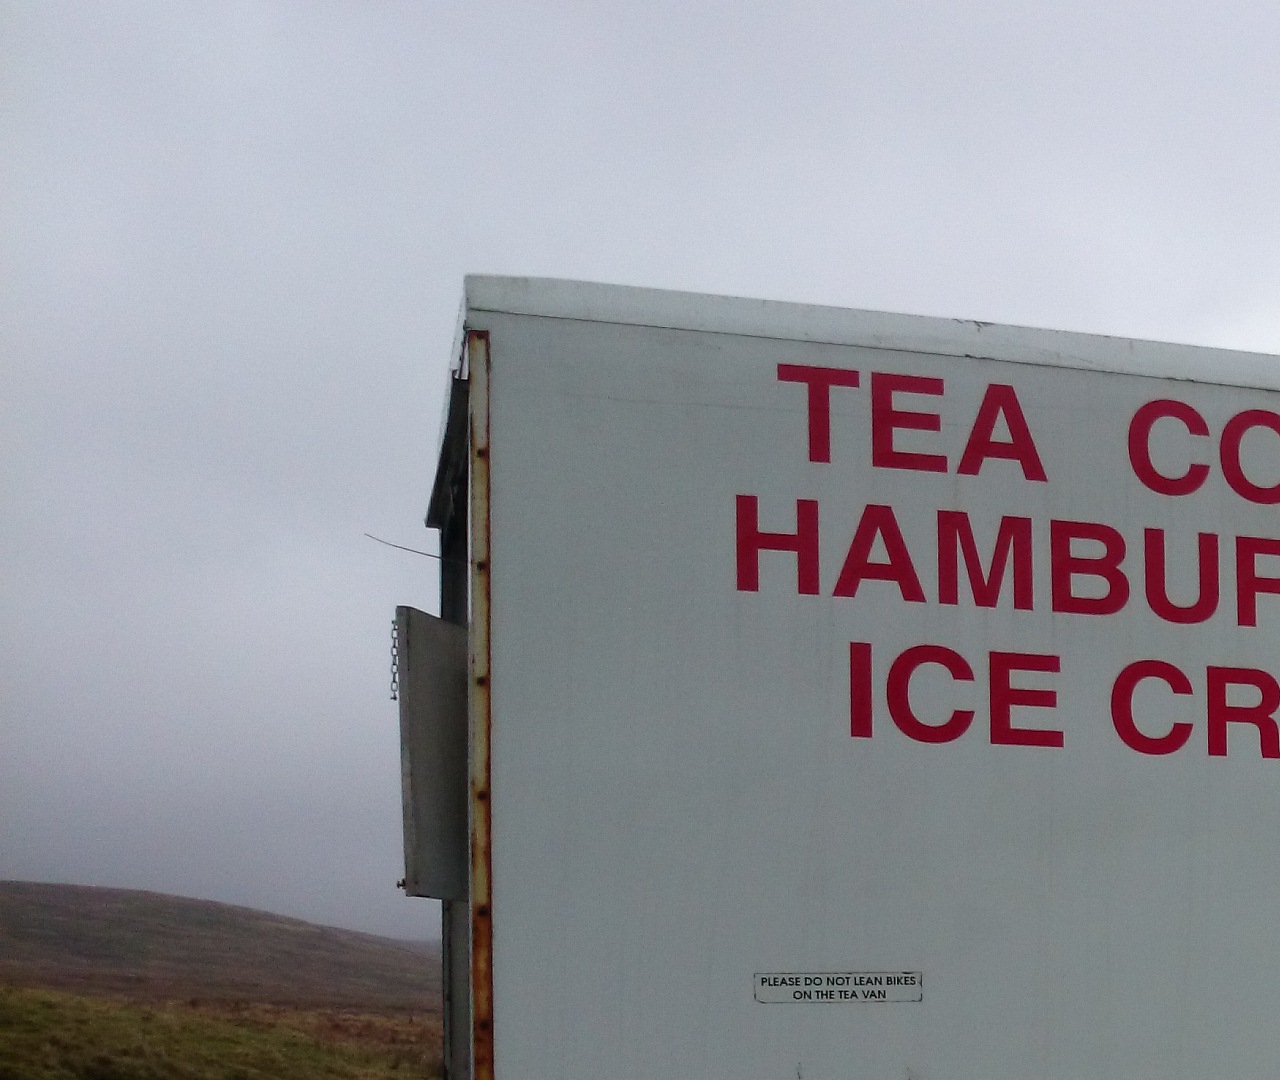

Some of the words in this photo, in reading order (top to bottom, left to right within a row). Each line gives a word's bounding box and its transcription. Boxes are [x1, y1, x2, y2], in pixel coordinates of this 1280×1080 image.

[778, 364, 1046, 481] TEA
[850, 642, 1063, 748] ICE
[760, 976, 801, 987] PLEASE
[804, 976, 823, 987] DO
[826, 976, 850, 986] NOT
[853, 976, 883, 986] LEAN
[886, 975, 917, 986] BIKES
[793, 990, 812, 1000] ON
[815, 990, 835, 1000] THE
[838, 990, 858, 999] TEA
[862, 989, 887, 999] VAN
